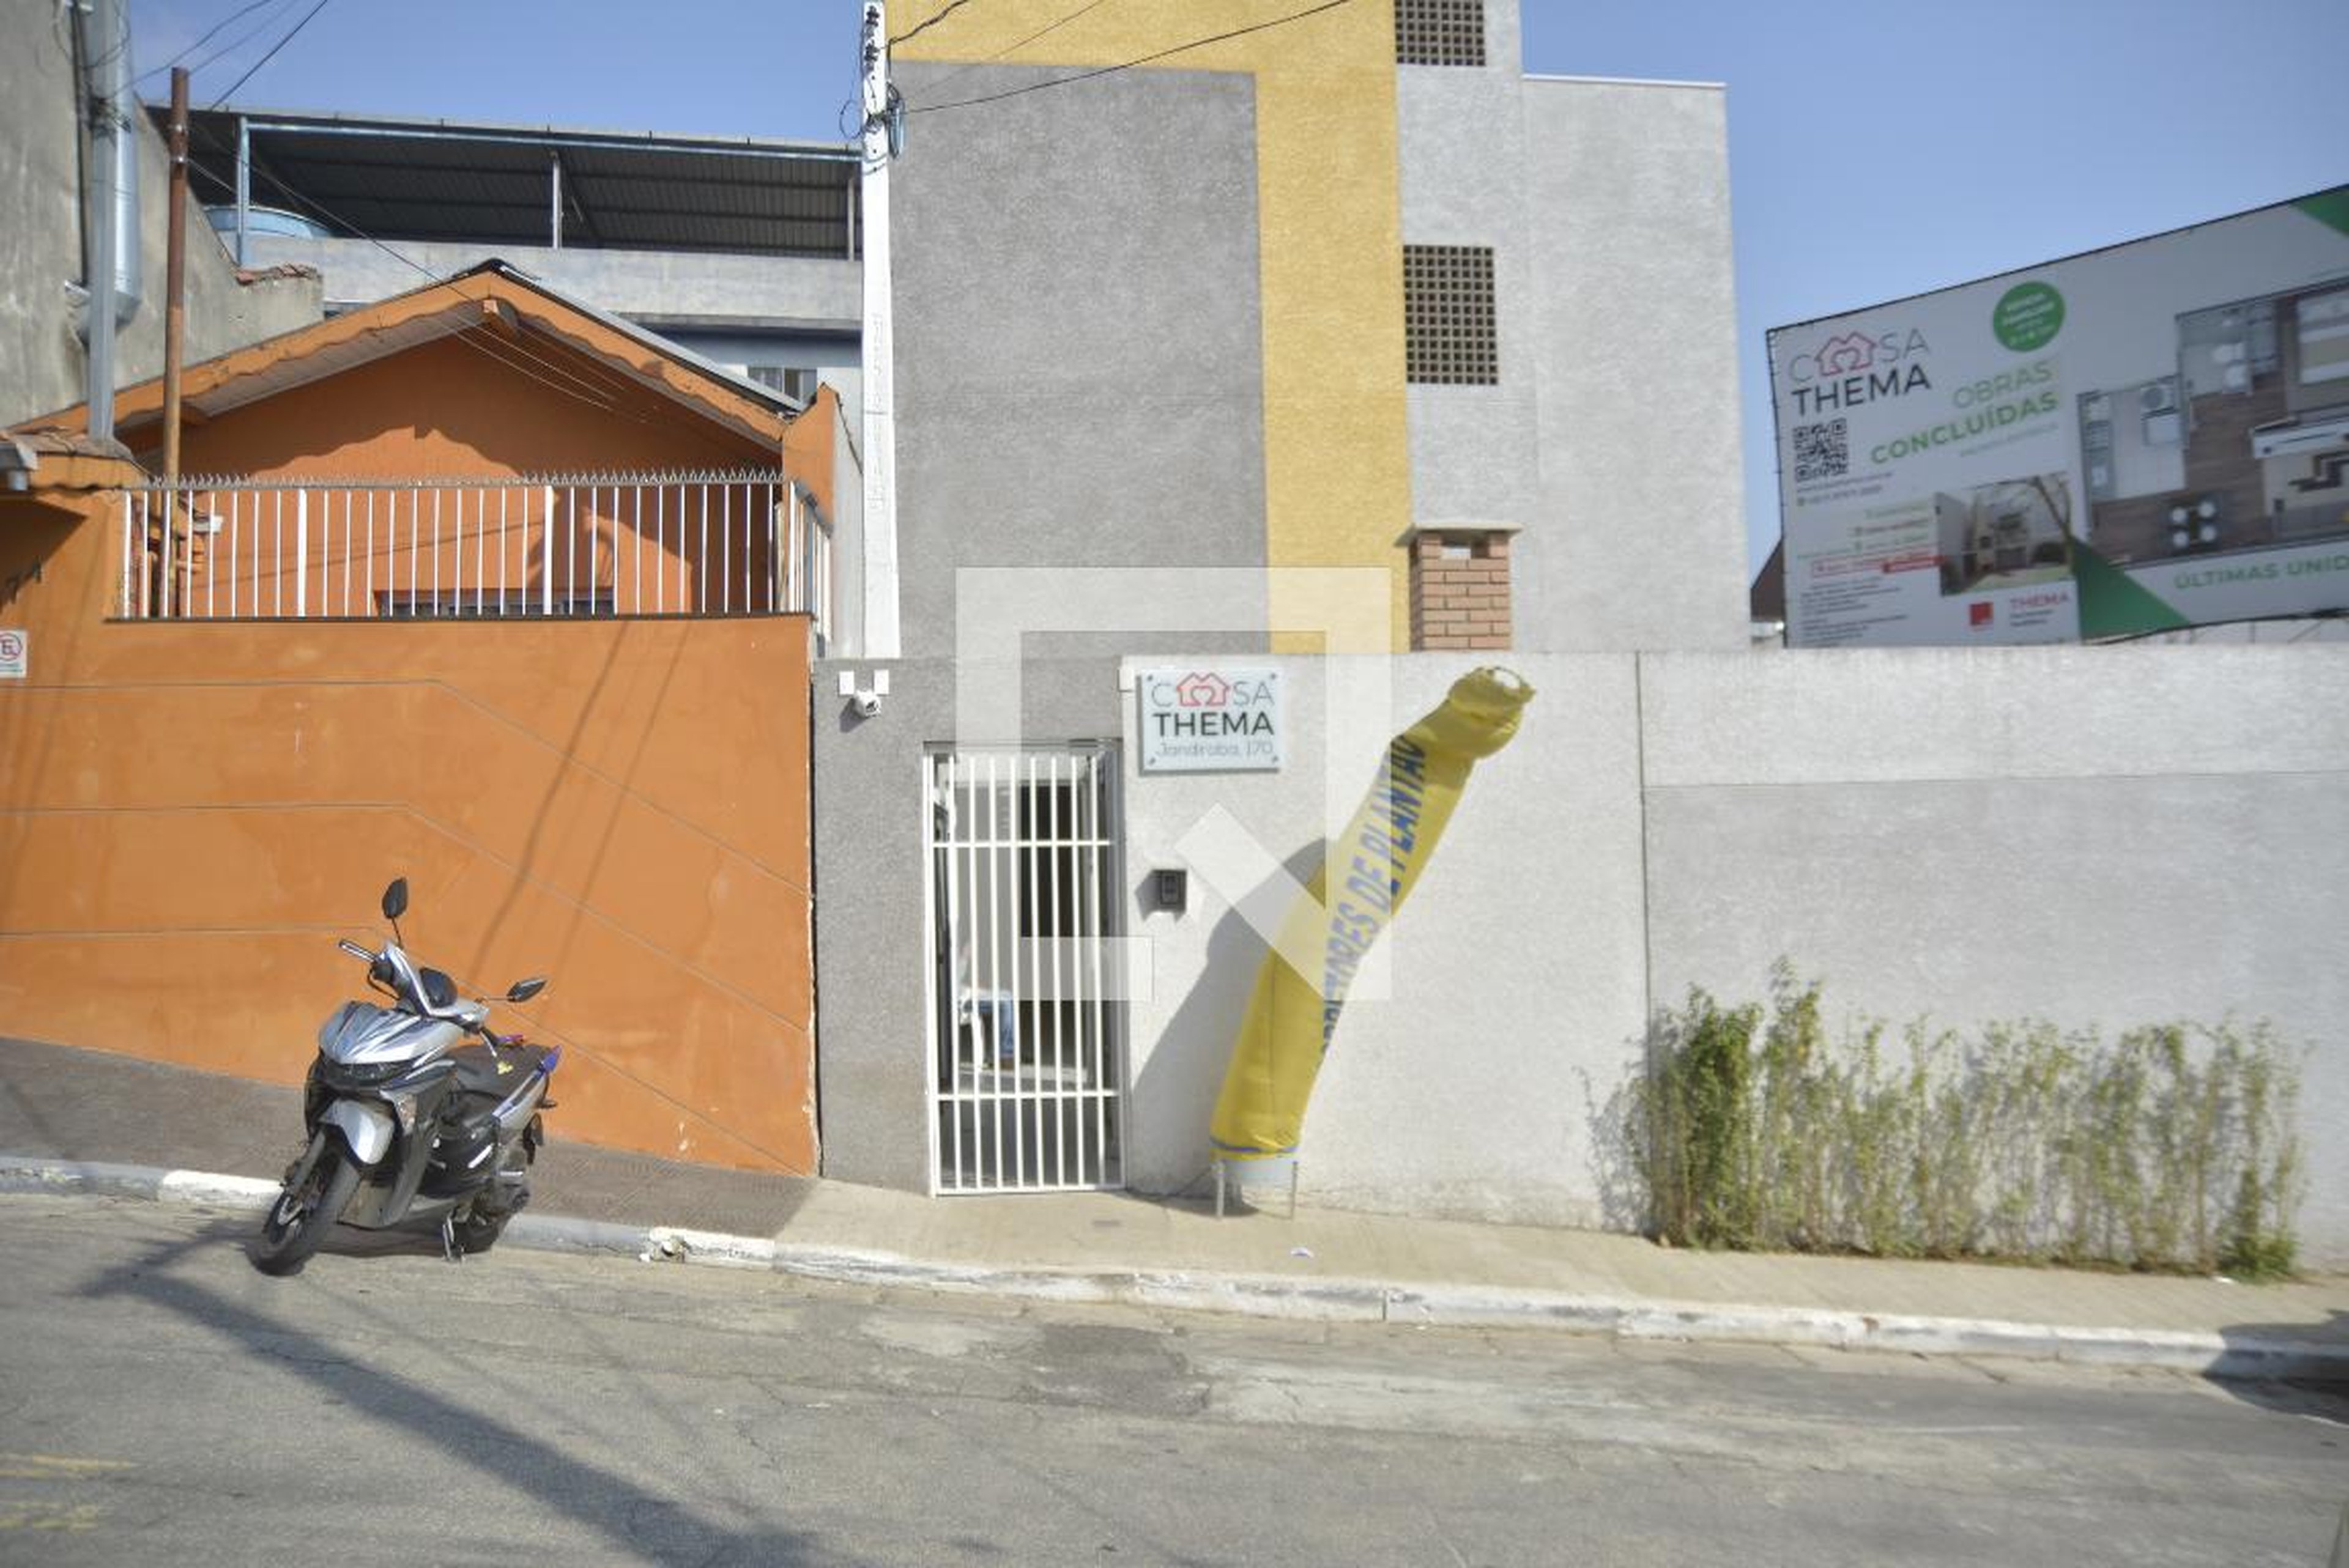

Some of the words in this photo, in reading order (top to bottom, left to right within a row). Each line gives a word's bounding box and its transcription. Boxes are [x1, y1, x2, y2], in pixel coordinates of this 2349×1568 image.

[1791, 363, 1932, 416] THEMA
[1953, 359, 2053, 409] OBRAS
[1871, 391, 2058, 465] CONCLUÍDAS
[1152, 711, 1274, 736] THEMA
[1347, 856, 1401, 914] DE
